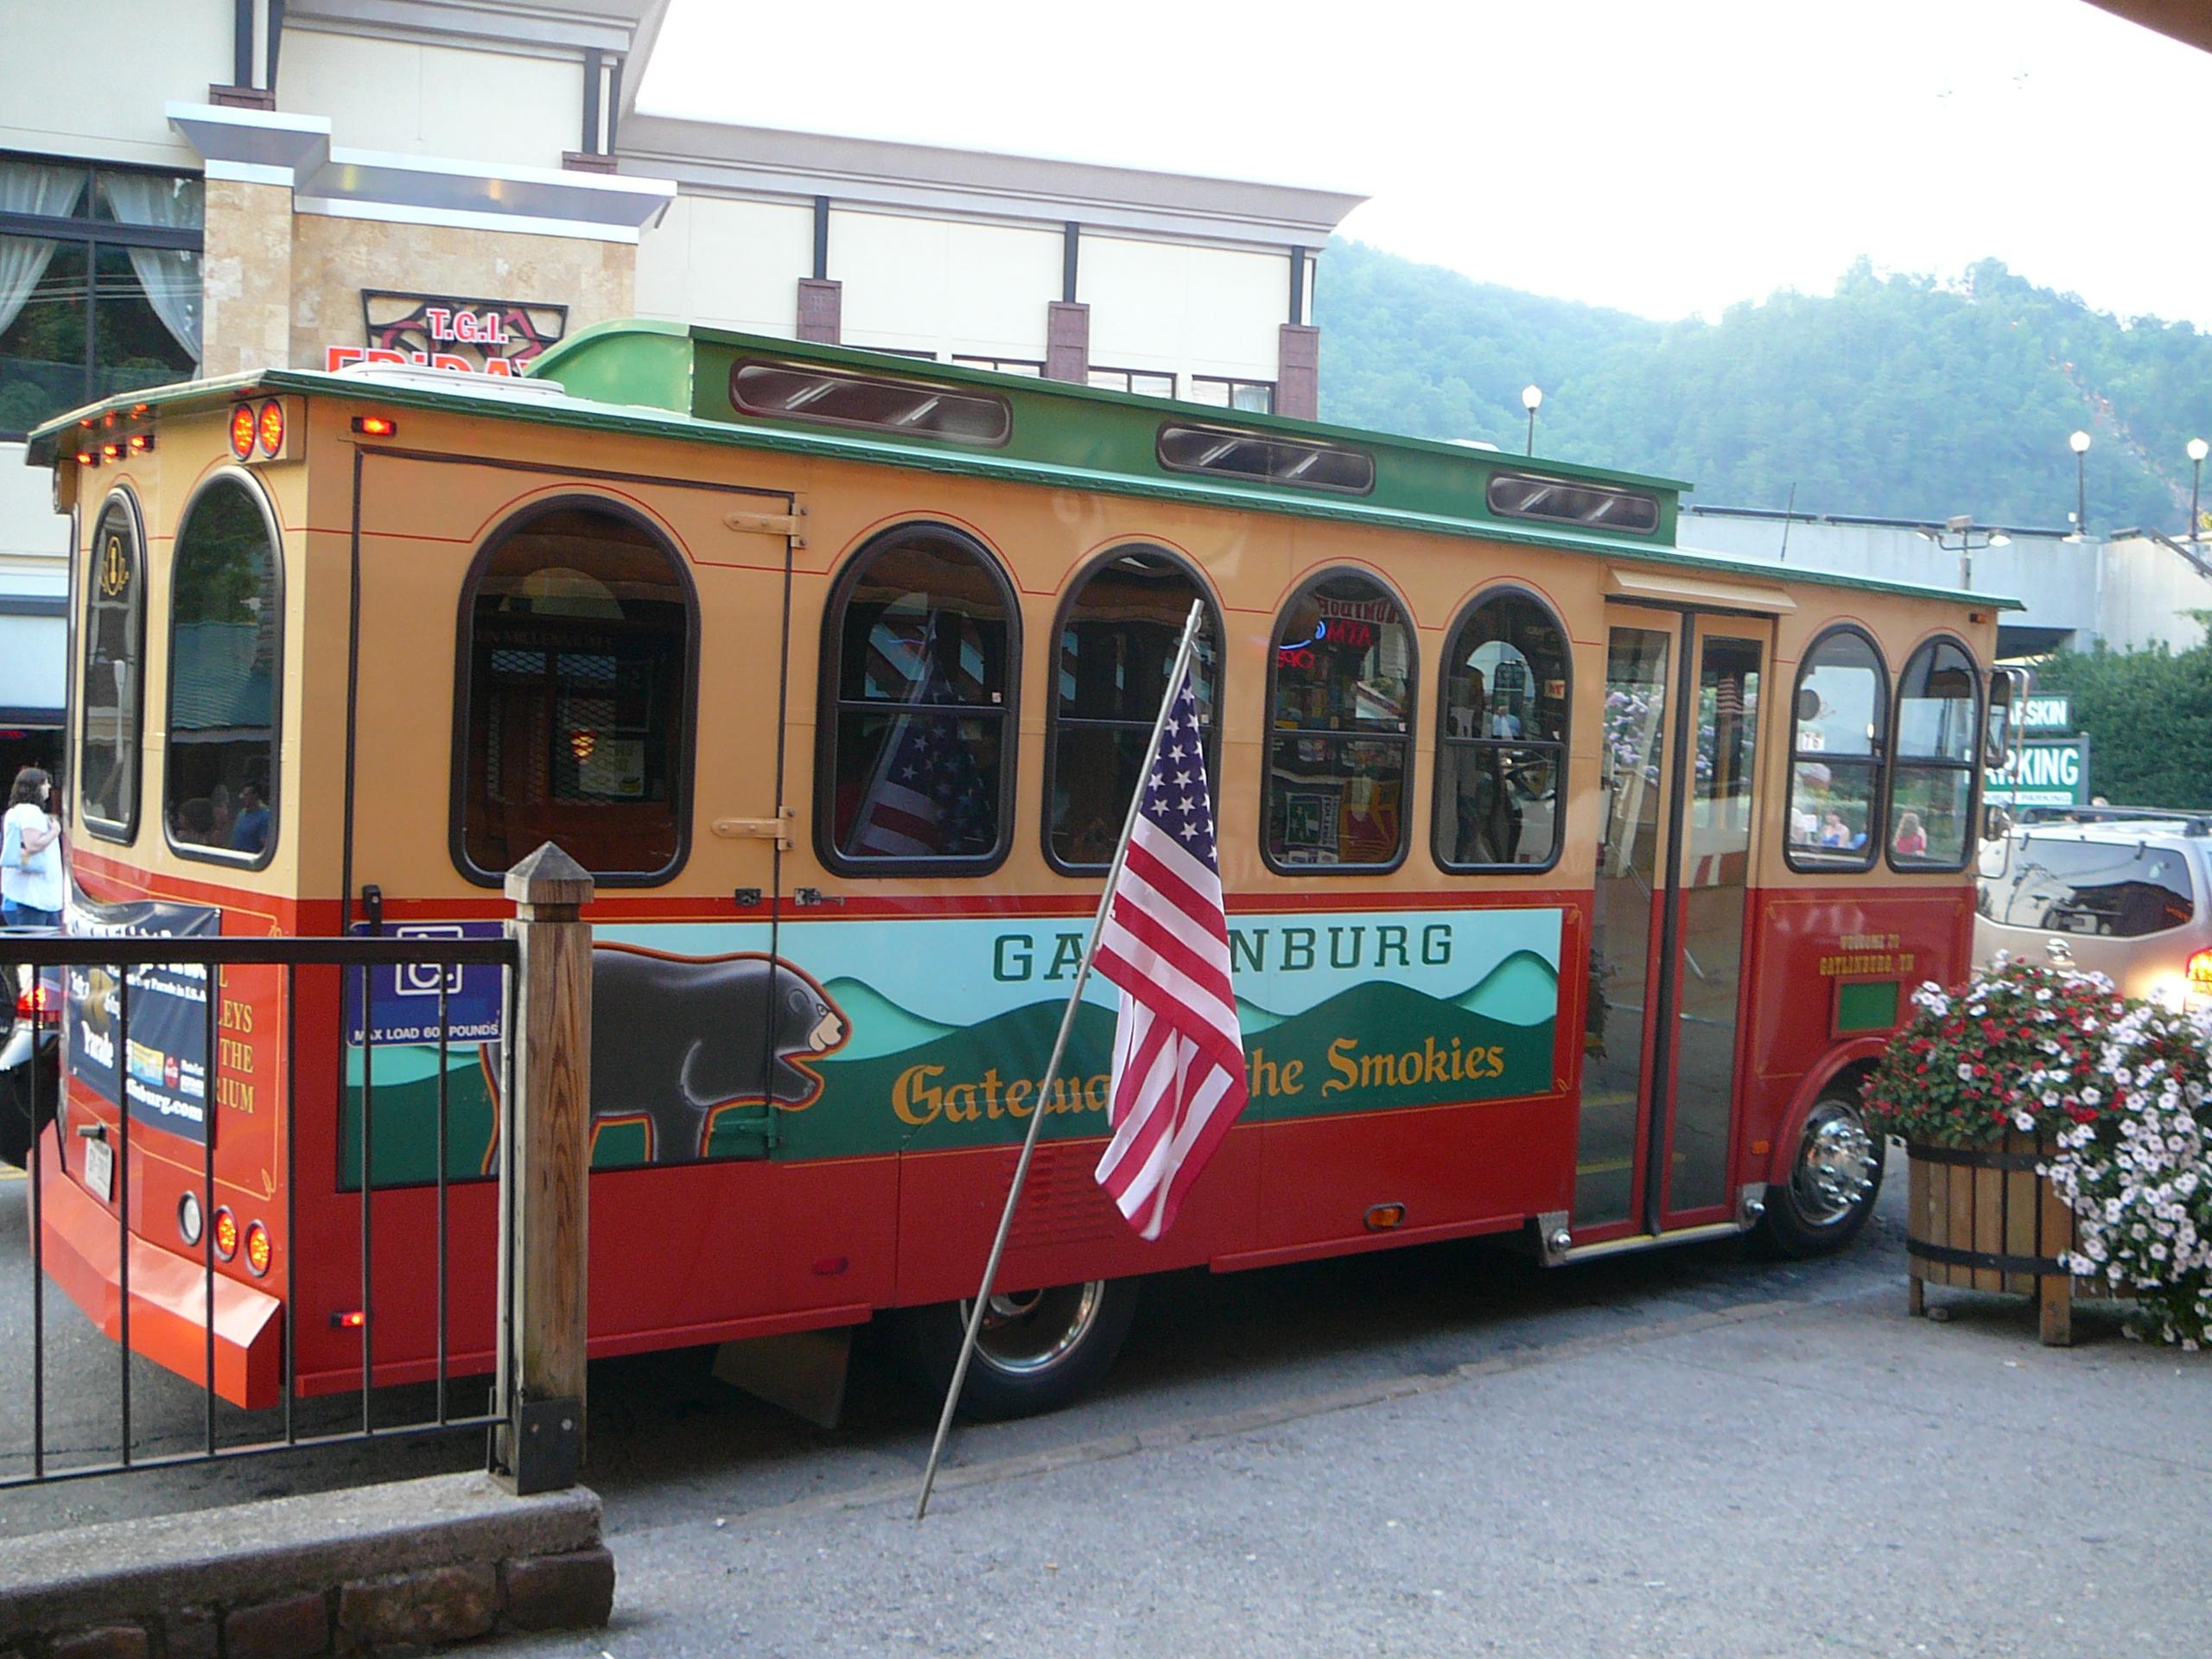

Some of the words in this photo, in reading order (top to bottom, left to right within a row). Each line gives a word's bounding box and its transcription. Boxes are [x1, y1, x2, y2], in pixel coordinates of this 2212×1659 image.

[427, 308, 509, 344] T.G.I.
[354, 1029, 383, 1041] MX
[386, 1027, 420, 1039] LOAD
[448, 1024, 499, 1037] POUNDS
[220, 1038, 253, 1073] THE
[1321, 1036, 1505, 1097] Smokies
